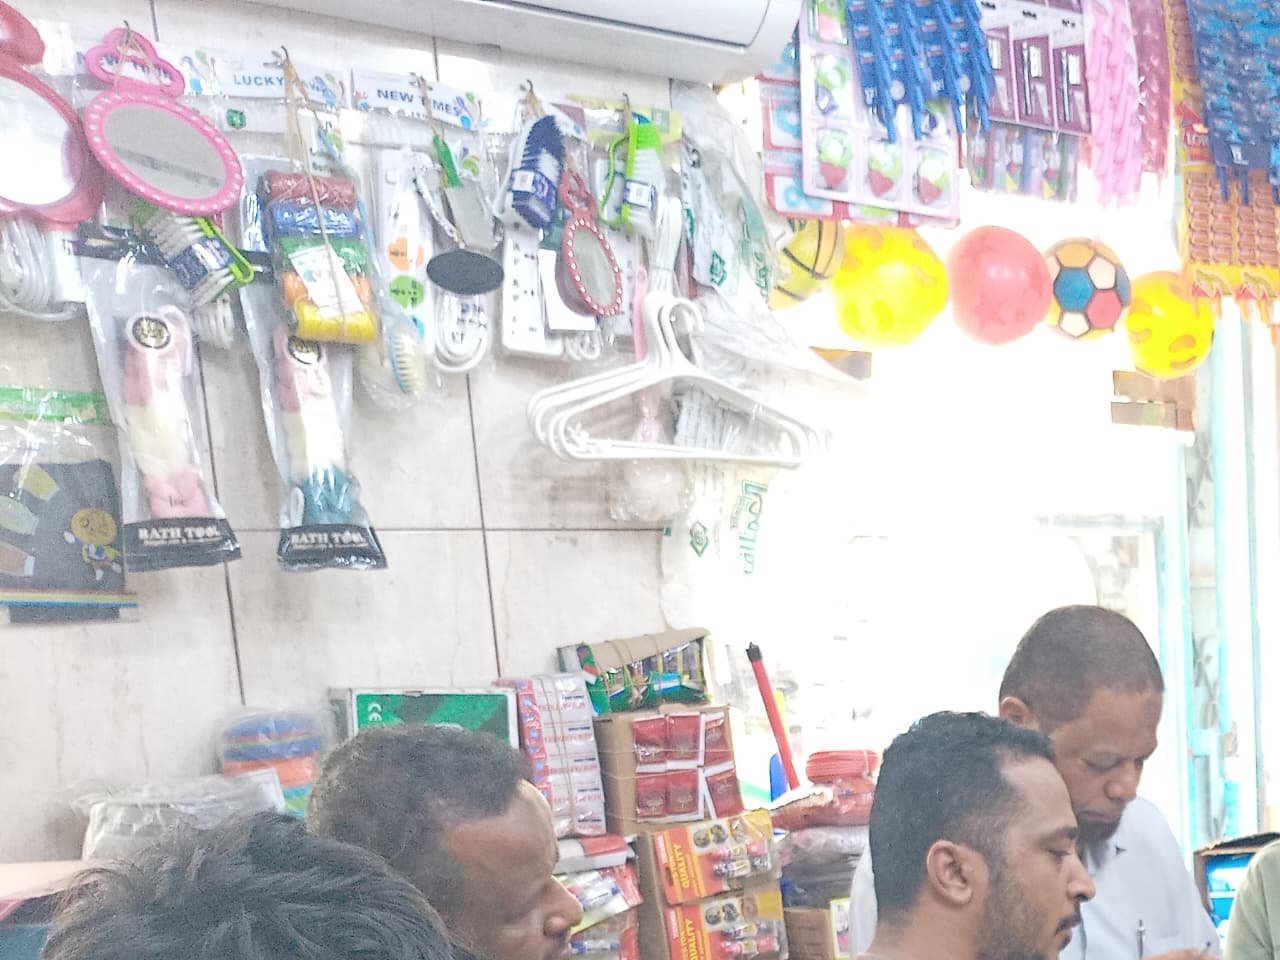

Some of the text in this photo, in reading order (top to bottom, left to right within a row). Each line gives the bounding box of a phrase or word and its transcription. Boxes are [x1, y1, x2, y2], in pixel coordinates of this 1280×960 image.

[233, 74, 284, 86] LUCKY
[376, 88, 463, 116] NEW TMES
[139, 525, 221, 541] BATH TOOL
[291, 532, 330, 544] BATH
[673, 844, 690, 888] QUALITY
